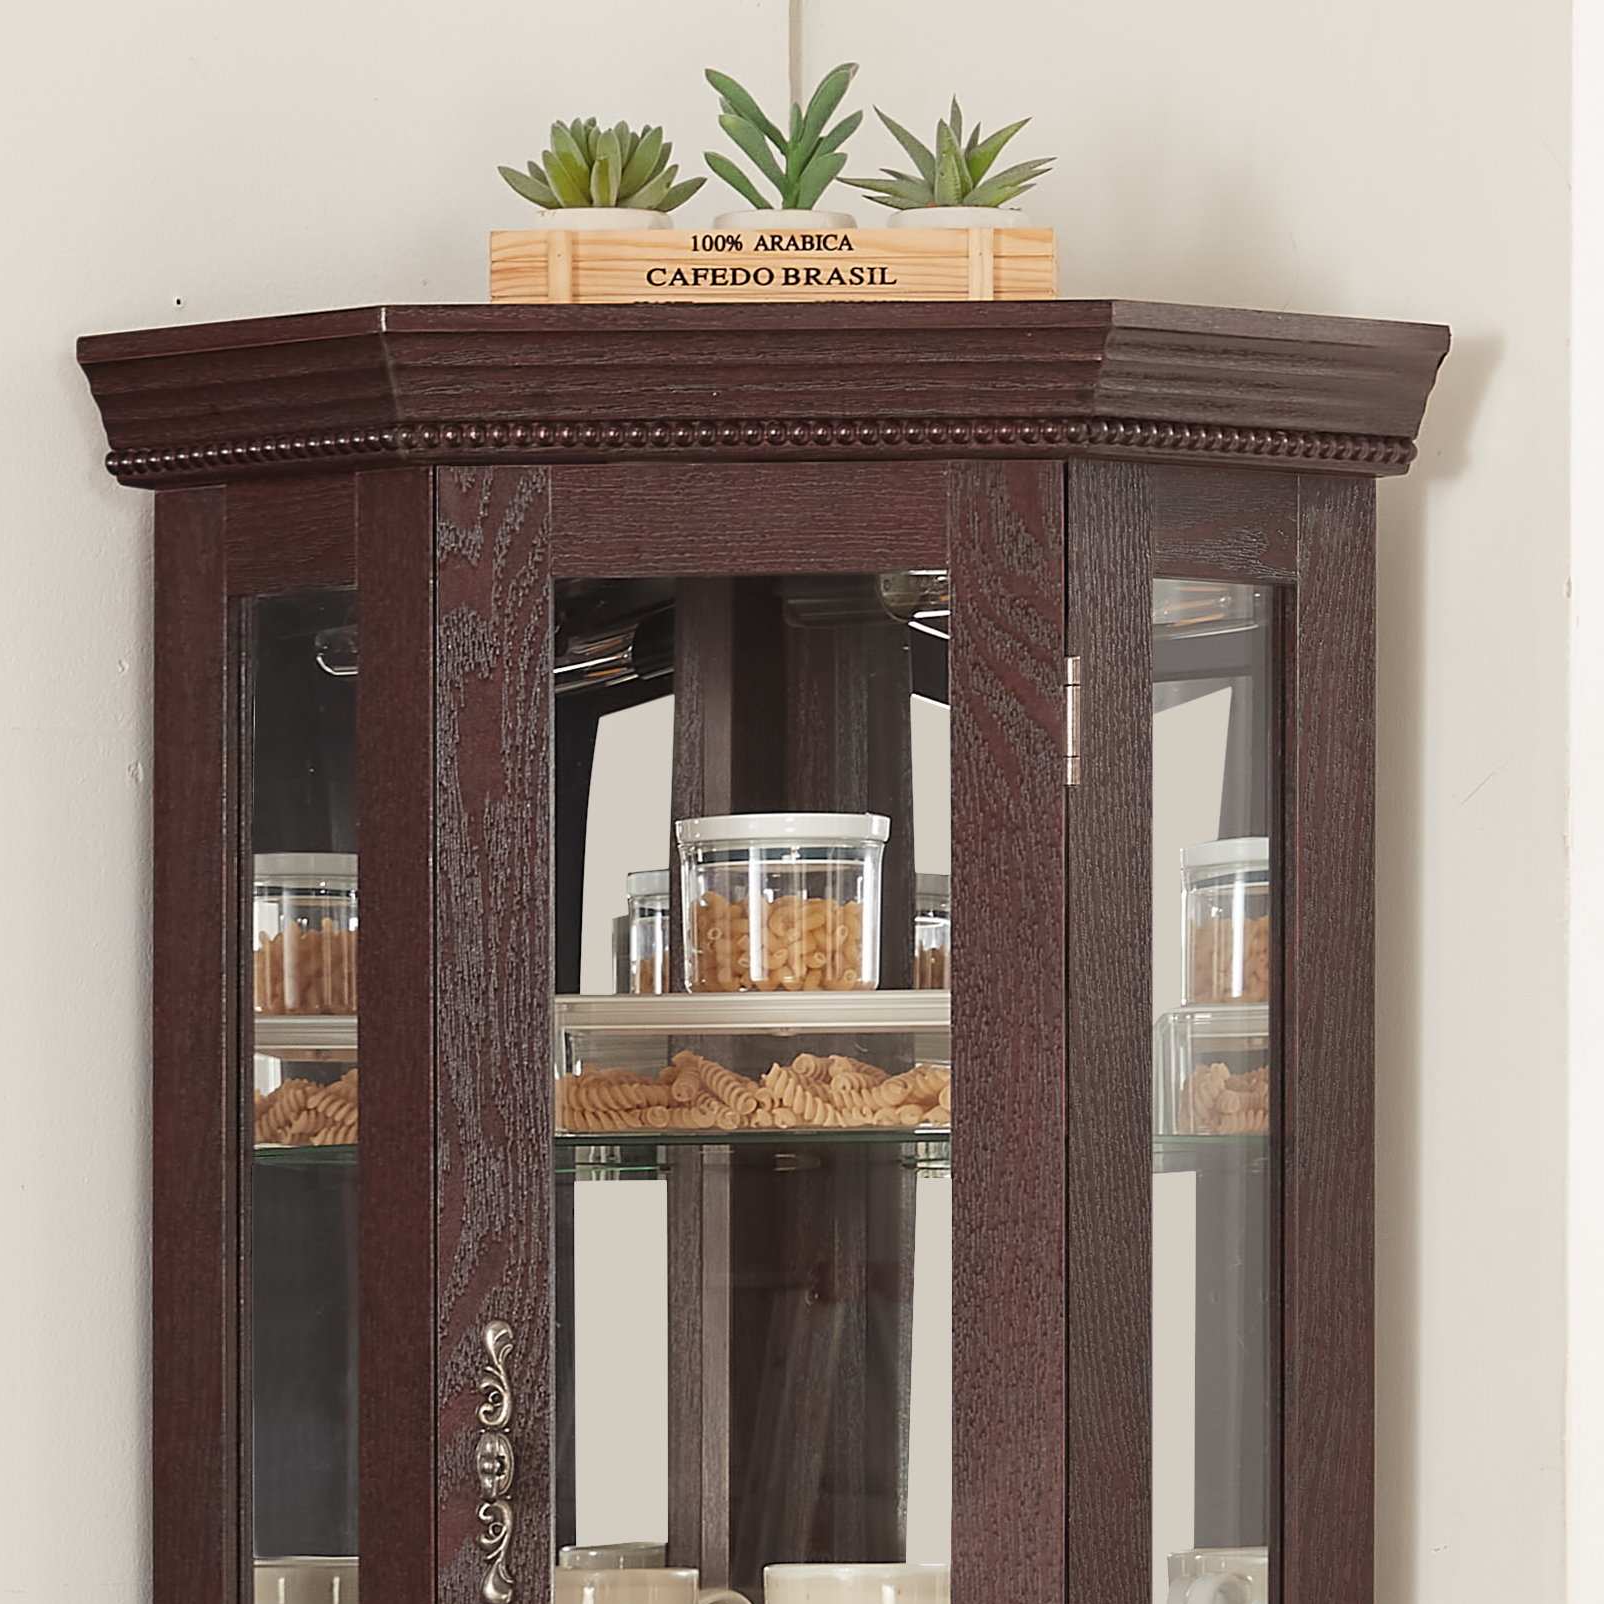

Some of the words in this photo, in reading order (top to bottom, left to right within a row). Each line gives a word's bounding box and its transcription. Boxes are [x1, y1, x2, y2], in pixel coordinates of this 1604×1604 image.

[691, 234, 743, 252] 100%
[753, 234, 854, 251] ARABICA
[646, 266, 775, 286] CAFEDO
[781, 266, 897, 286] BRASIL
